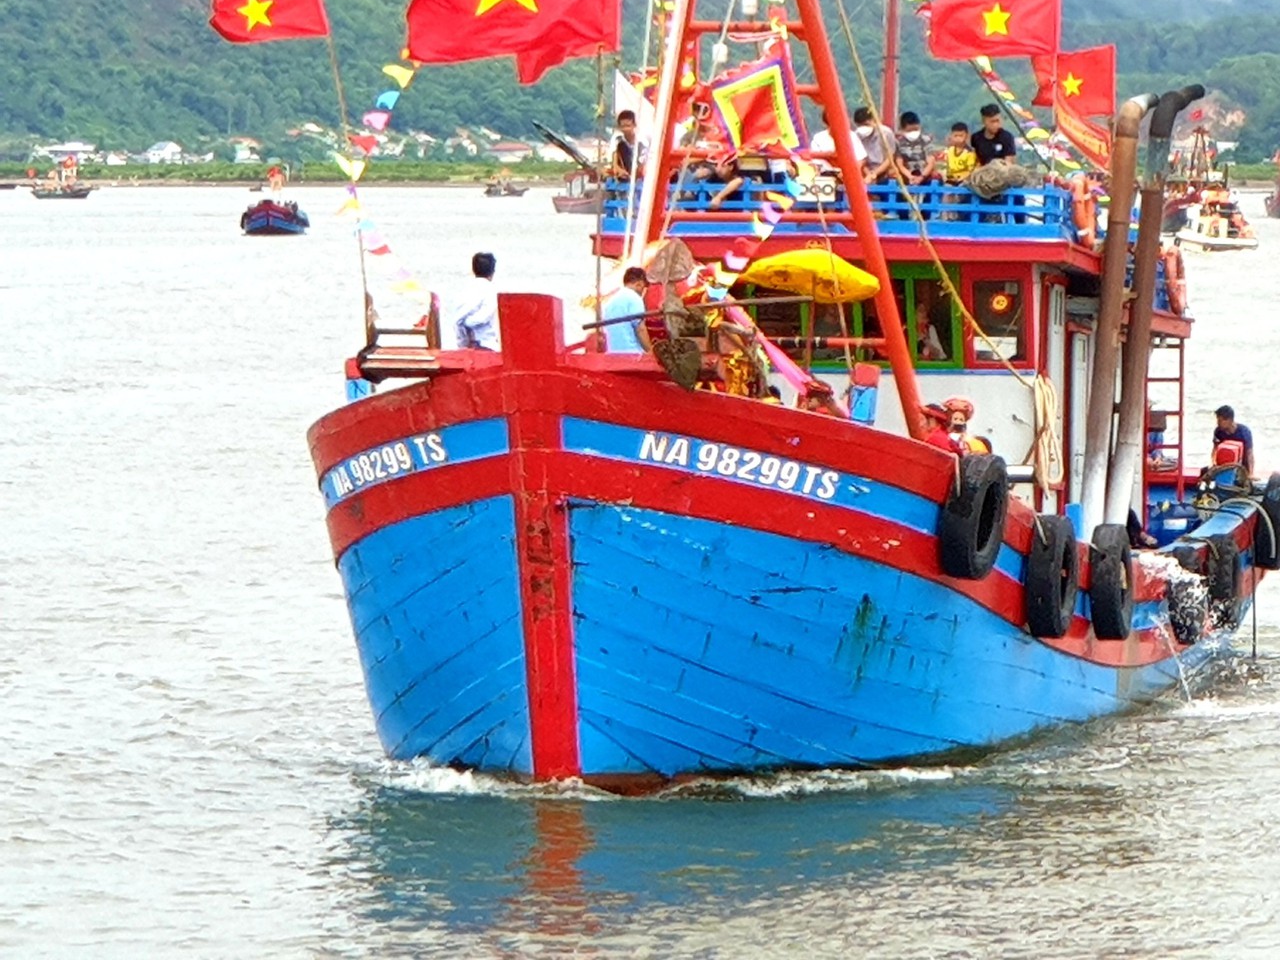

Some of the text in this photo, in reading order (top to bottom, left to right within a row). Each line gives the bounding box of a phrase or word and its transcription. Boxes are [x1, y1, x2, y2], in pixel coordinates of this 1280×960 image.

[349, 442, 412, 487] 98299
[413, 433, 446, 465] TS
[638, 433, 839, 499] NA 98299 TS
